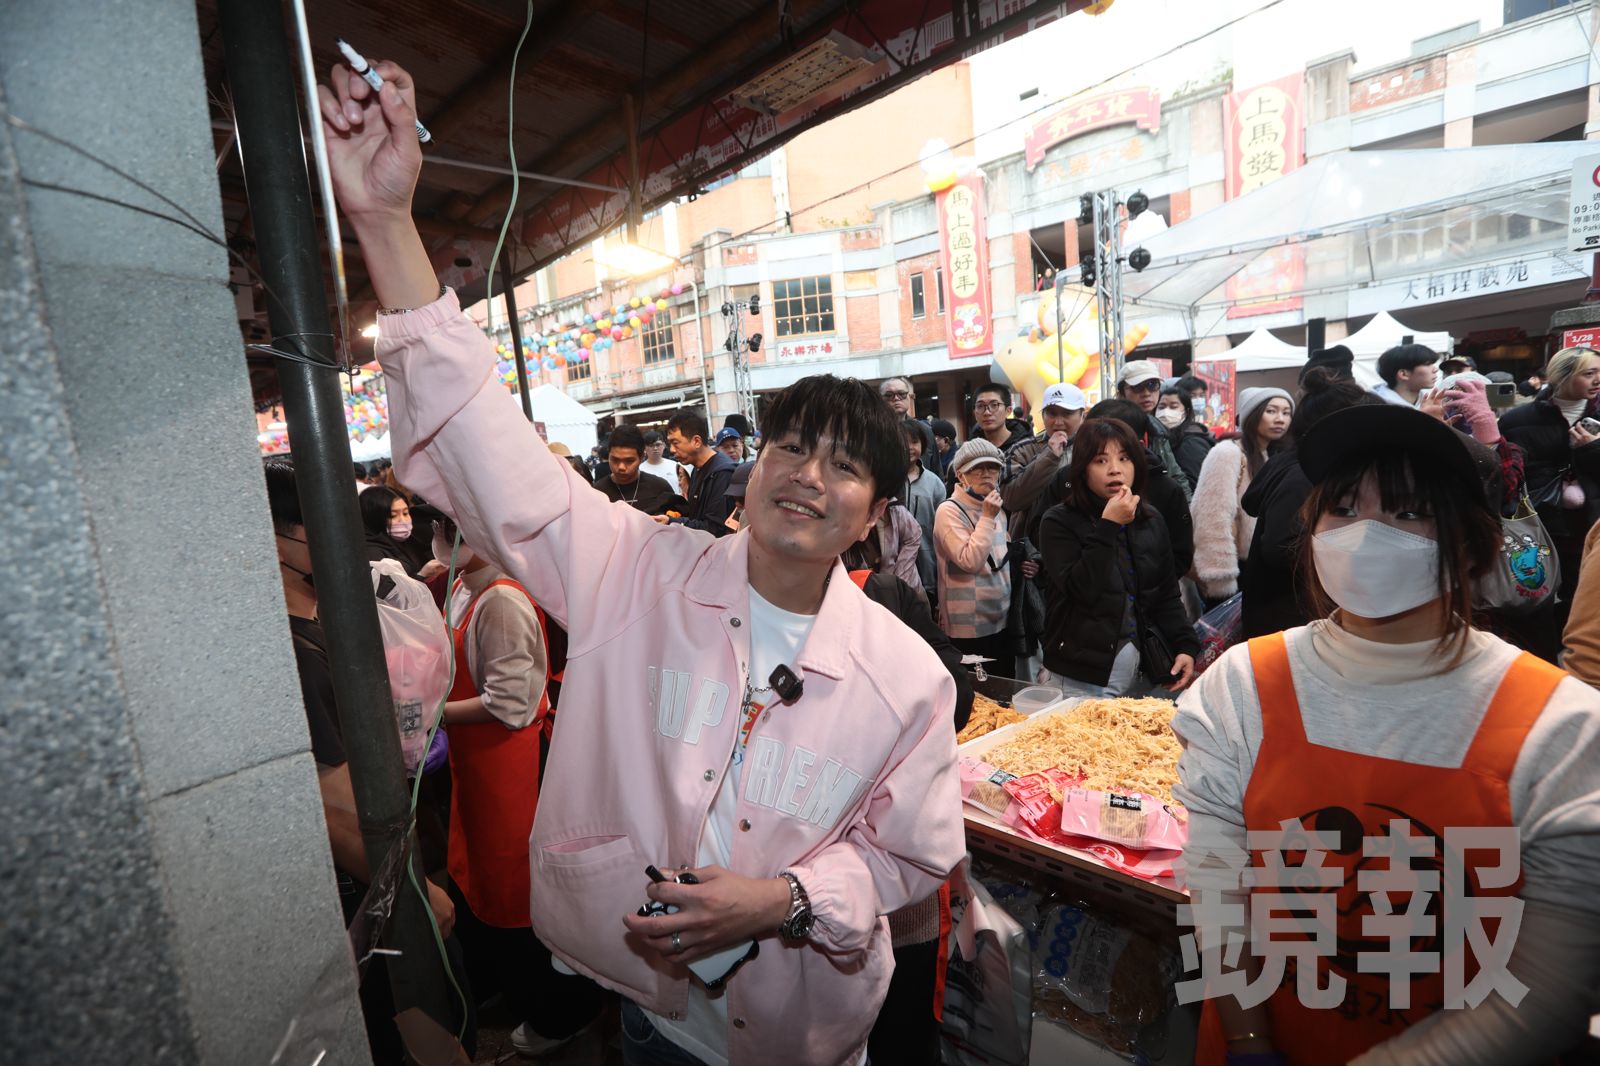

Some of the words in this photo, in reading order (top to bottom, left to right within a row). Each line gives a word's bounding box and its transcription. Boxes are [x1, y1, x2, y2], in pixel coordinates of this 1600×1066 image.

[1246, 97, 1279, 187] 上馬發
[951, 191, 976, 292] 馬上過好年
[1571, 334, 1594, 343] 1/28
[648, 666, 730, 745] UP
